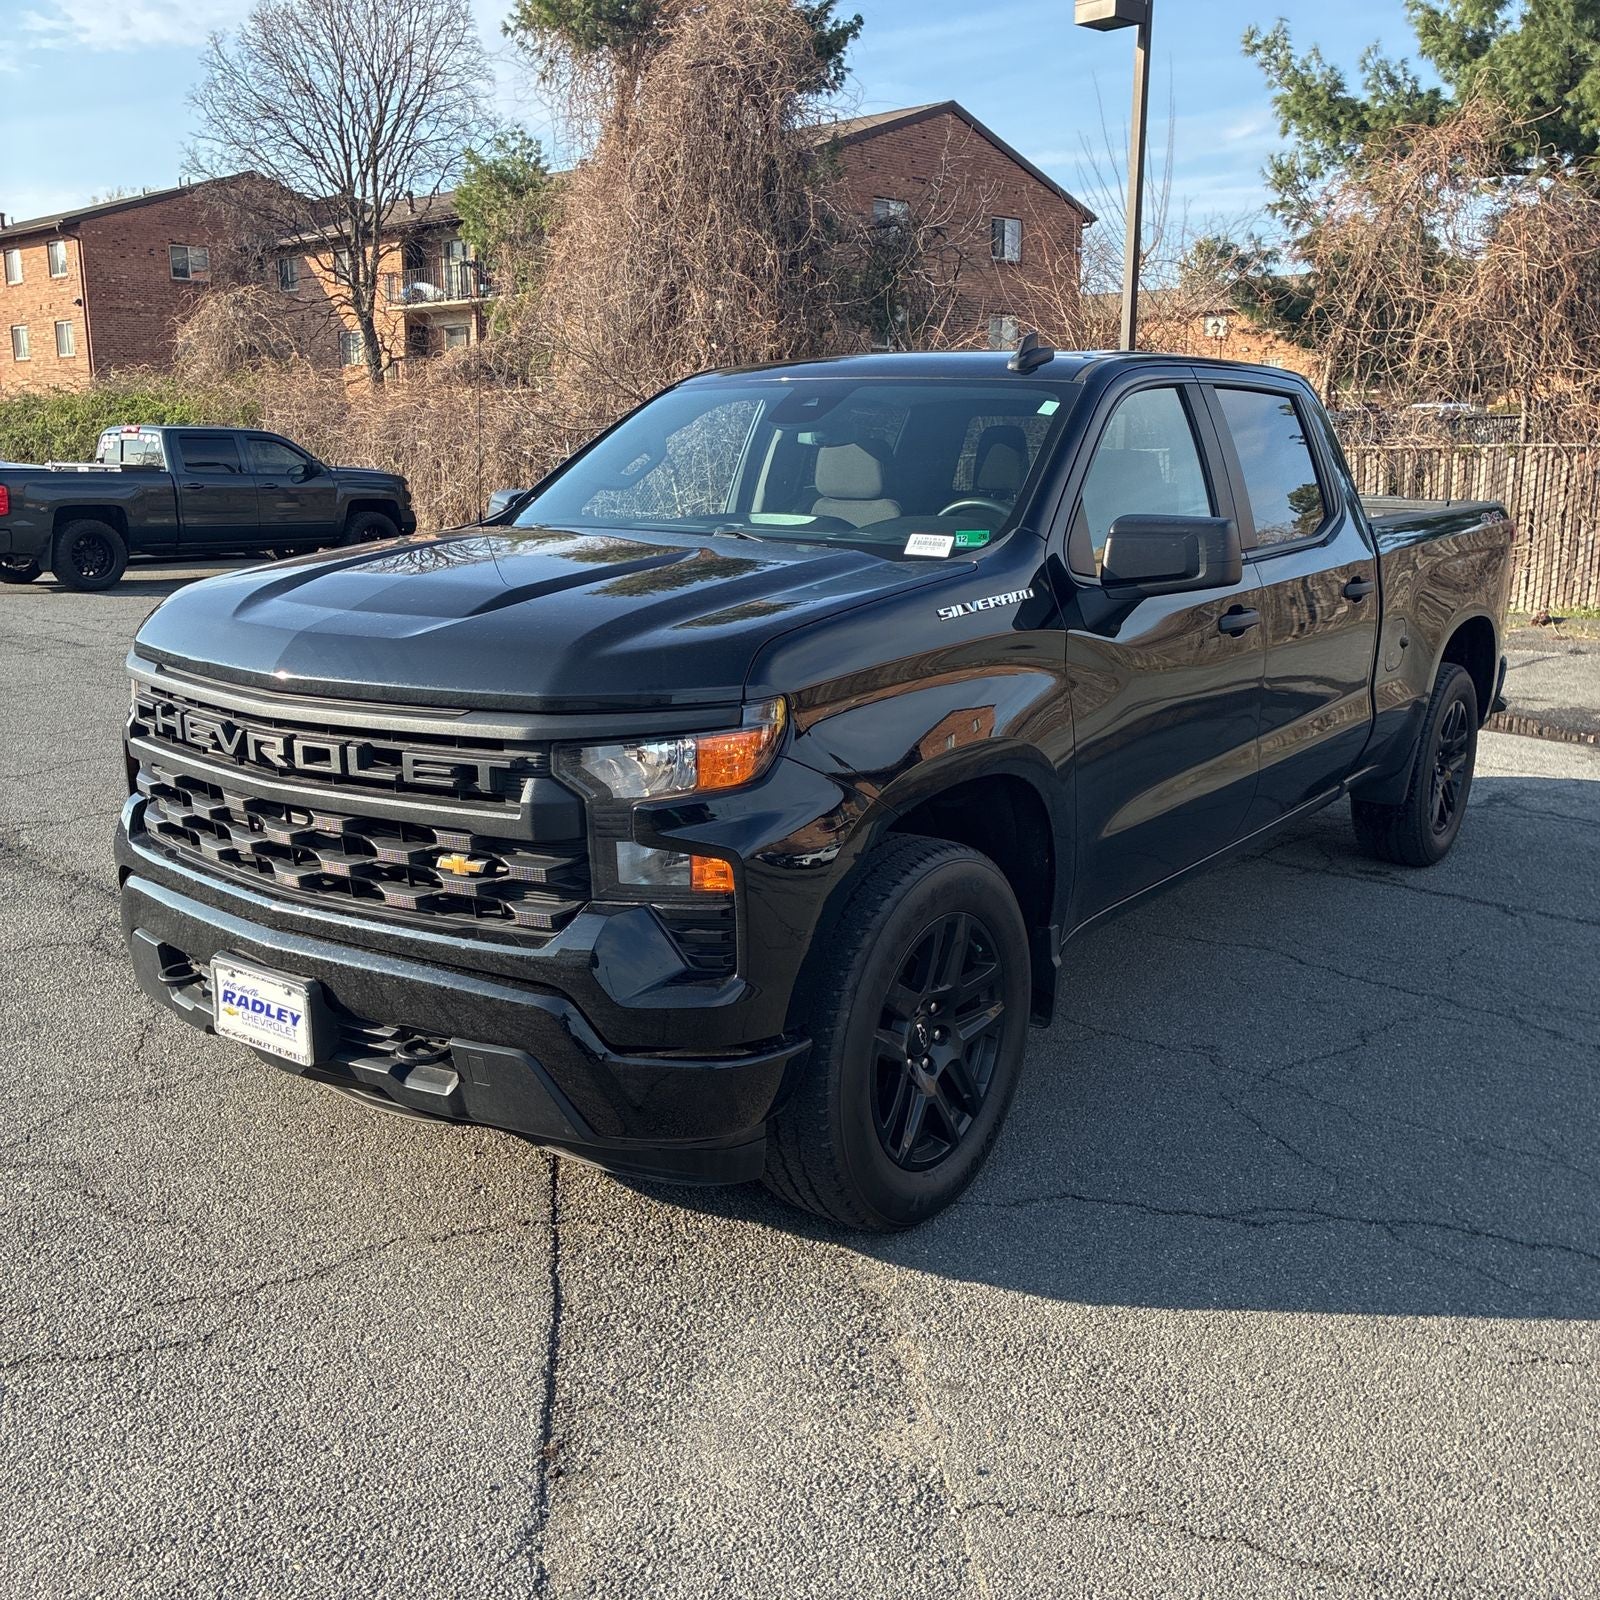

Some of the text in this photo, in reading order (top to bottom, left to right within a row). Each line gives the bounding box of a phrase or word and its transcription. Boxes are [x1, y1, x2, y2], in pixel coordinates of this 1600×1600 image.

[958, 535, 968, 543] 12
[937, 588, 1034, 621] SILVERADO
[134, 697, 522, 792] CHEVROLET
[222, 989, 301, 1027] RADLEY
[241, 1011, 298, 1038] CHEVROLET
[249, 1037, 271, 1050] RADLEY
